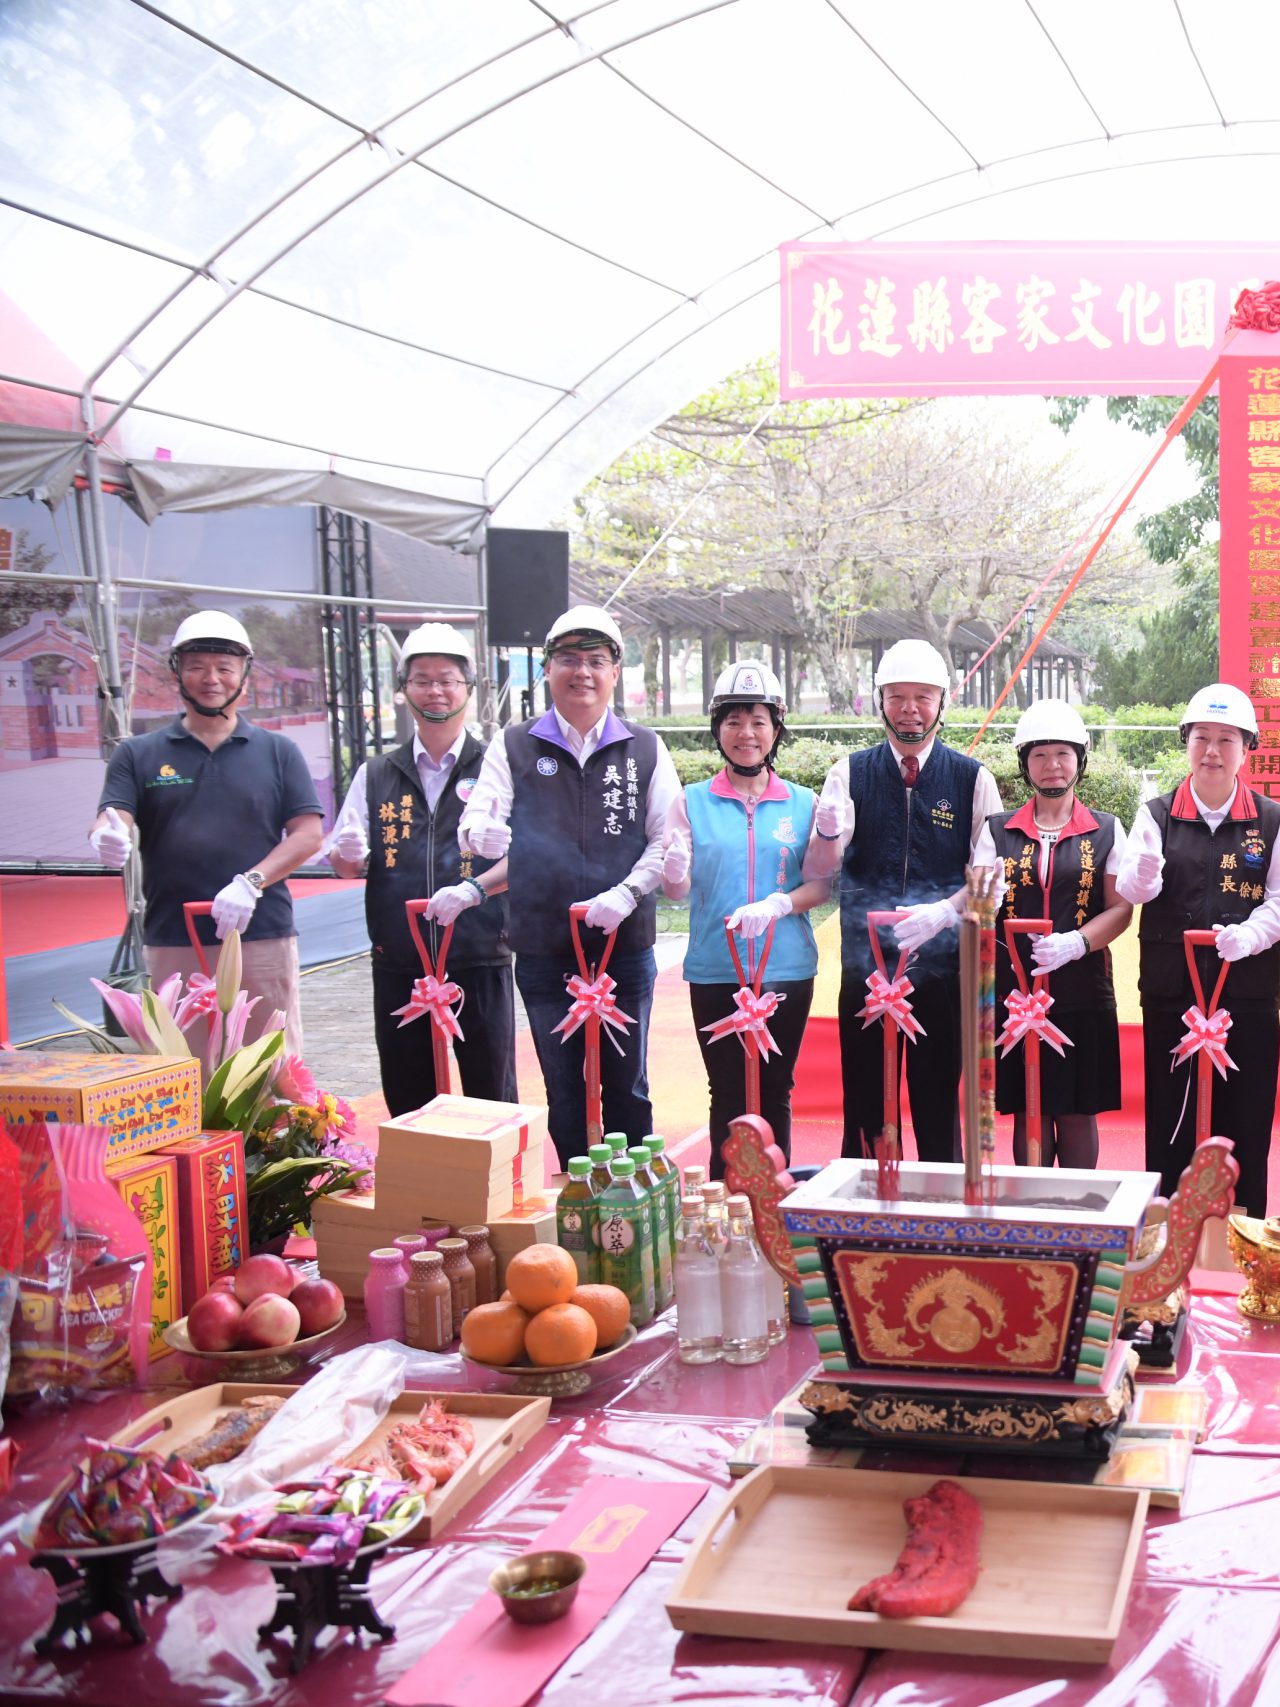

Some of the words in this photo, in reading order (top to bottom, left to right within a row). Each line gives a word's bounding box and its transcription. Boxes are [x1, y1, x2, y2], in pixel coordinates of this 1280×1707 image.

[602, 765, 624, 835] 吳建志
[626, 757, 639, 822] 花蓮縣議員
[378, 801, 399, 868] 林源富
[1019, 842, 1036, 887] 副議長
[1074, 839, 1096, 926] 花蓮縣議會
[1219, 853, 1238, 893] 縣長
[604, 1213, 625, 1256] 原萃
